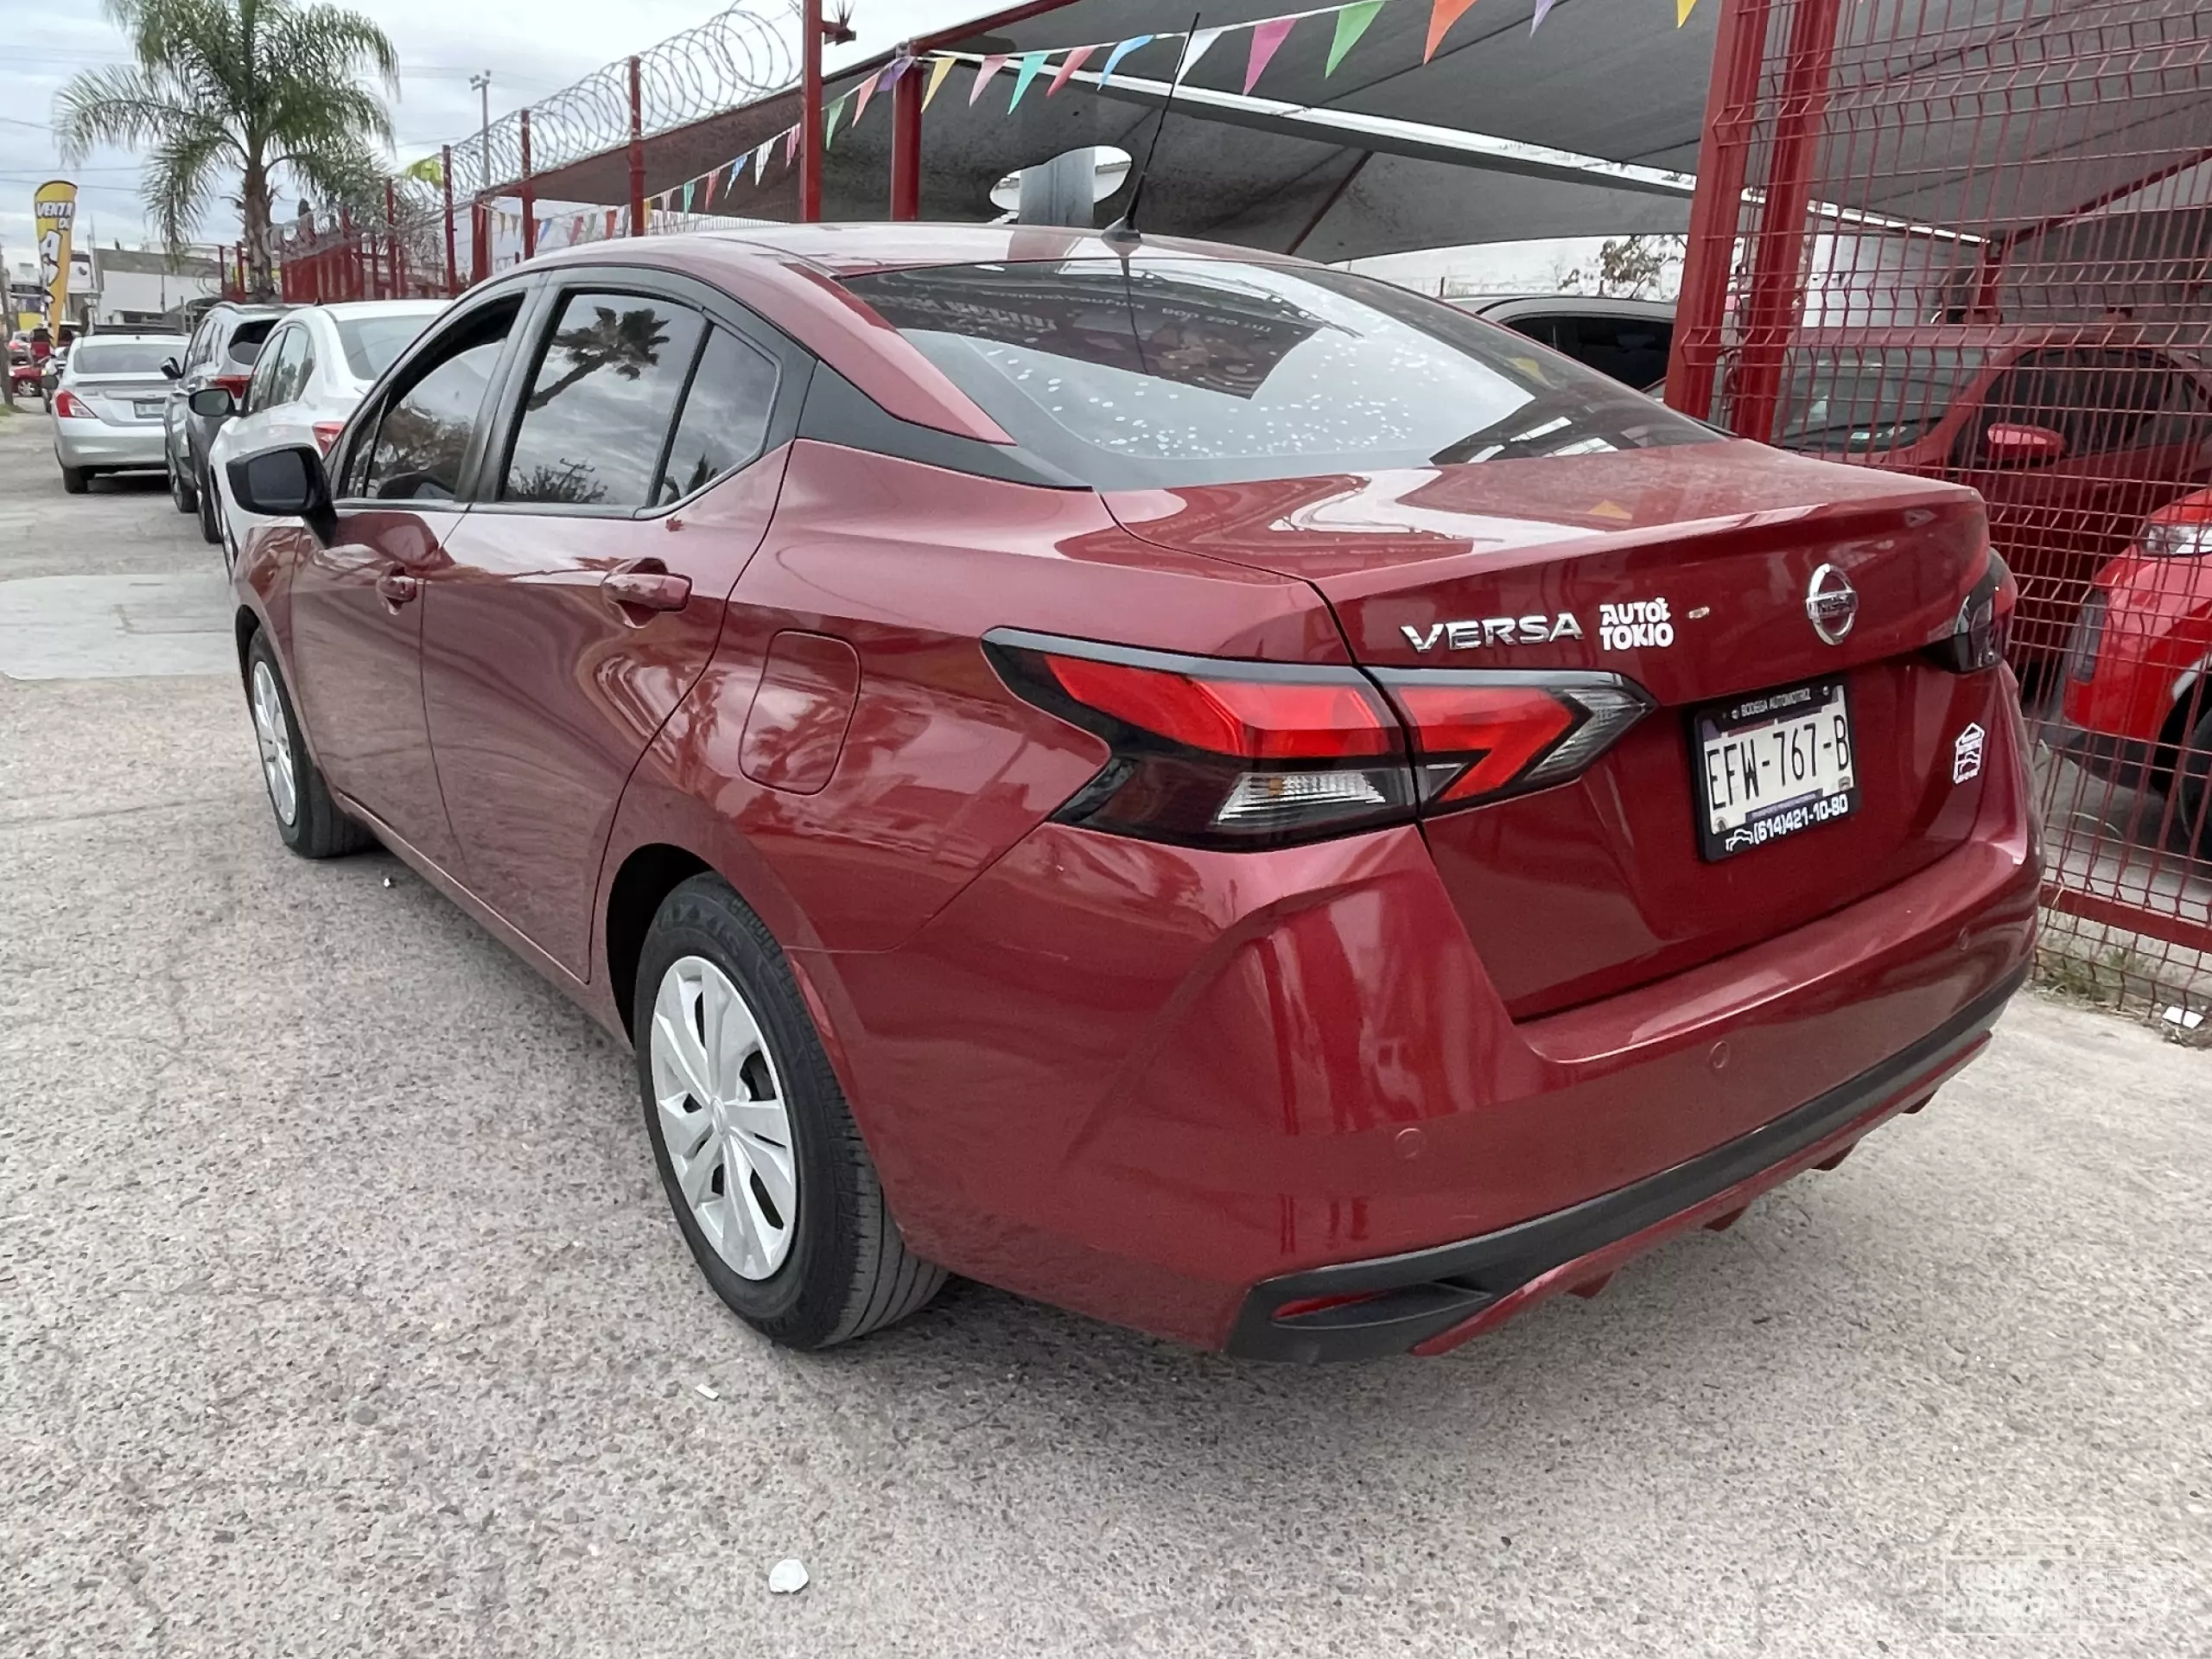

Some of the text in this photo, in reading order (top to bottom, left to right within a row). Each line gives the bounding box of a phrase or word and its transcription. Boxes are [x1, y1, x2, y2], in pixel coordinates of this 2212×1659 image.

[36, 201, 73, 219] VENTA
[1401, 612, 1584, 653] VERSA
[1599, 622, 1675, 651] TOKIO
[1707, 715, 1851, 810] EFW-767-B
[1753, 793, 1849, 844] (614)421-10-80
